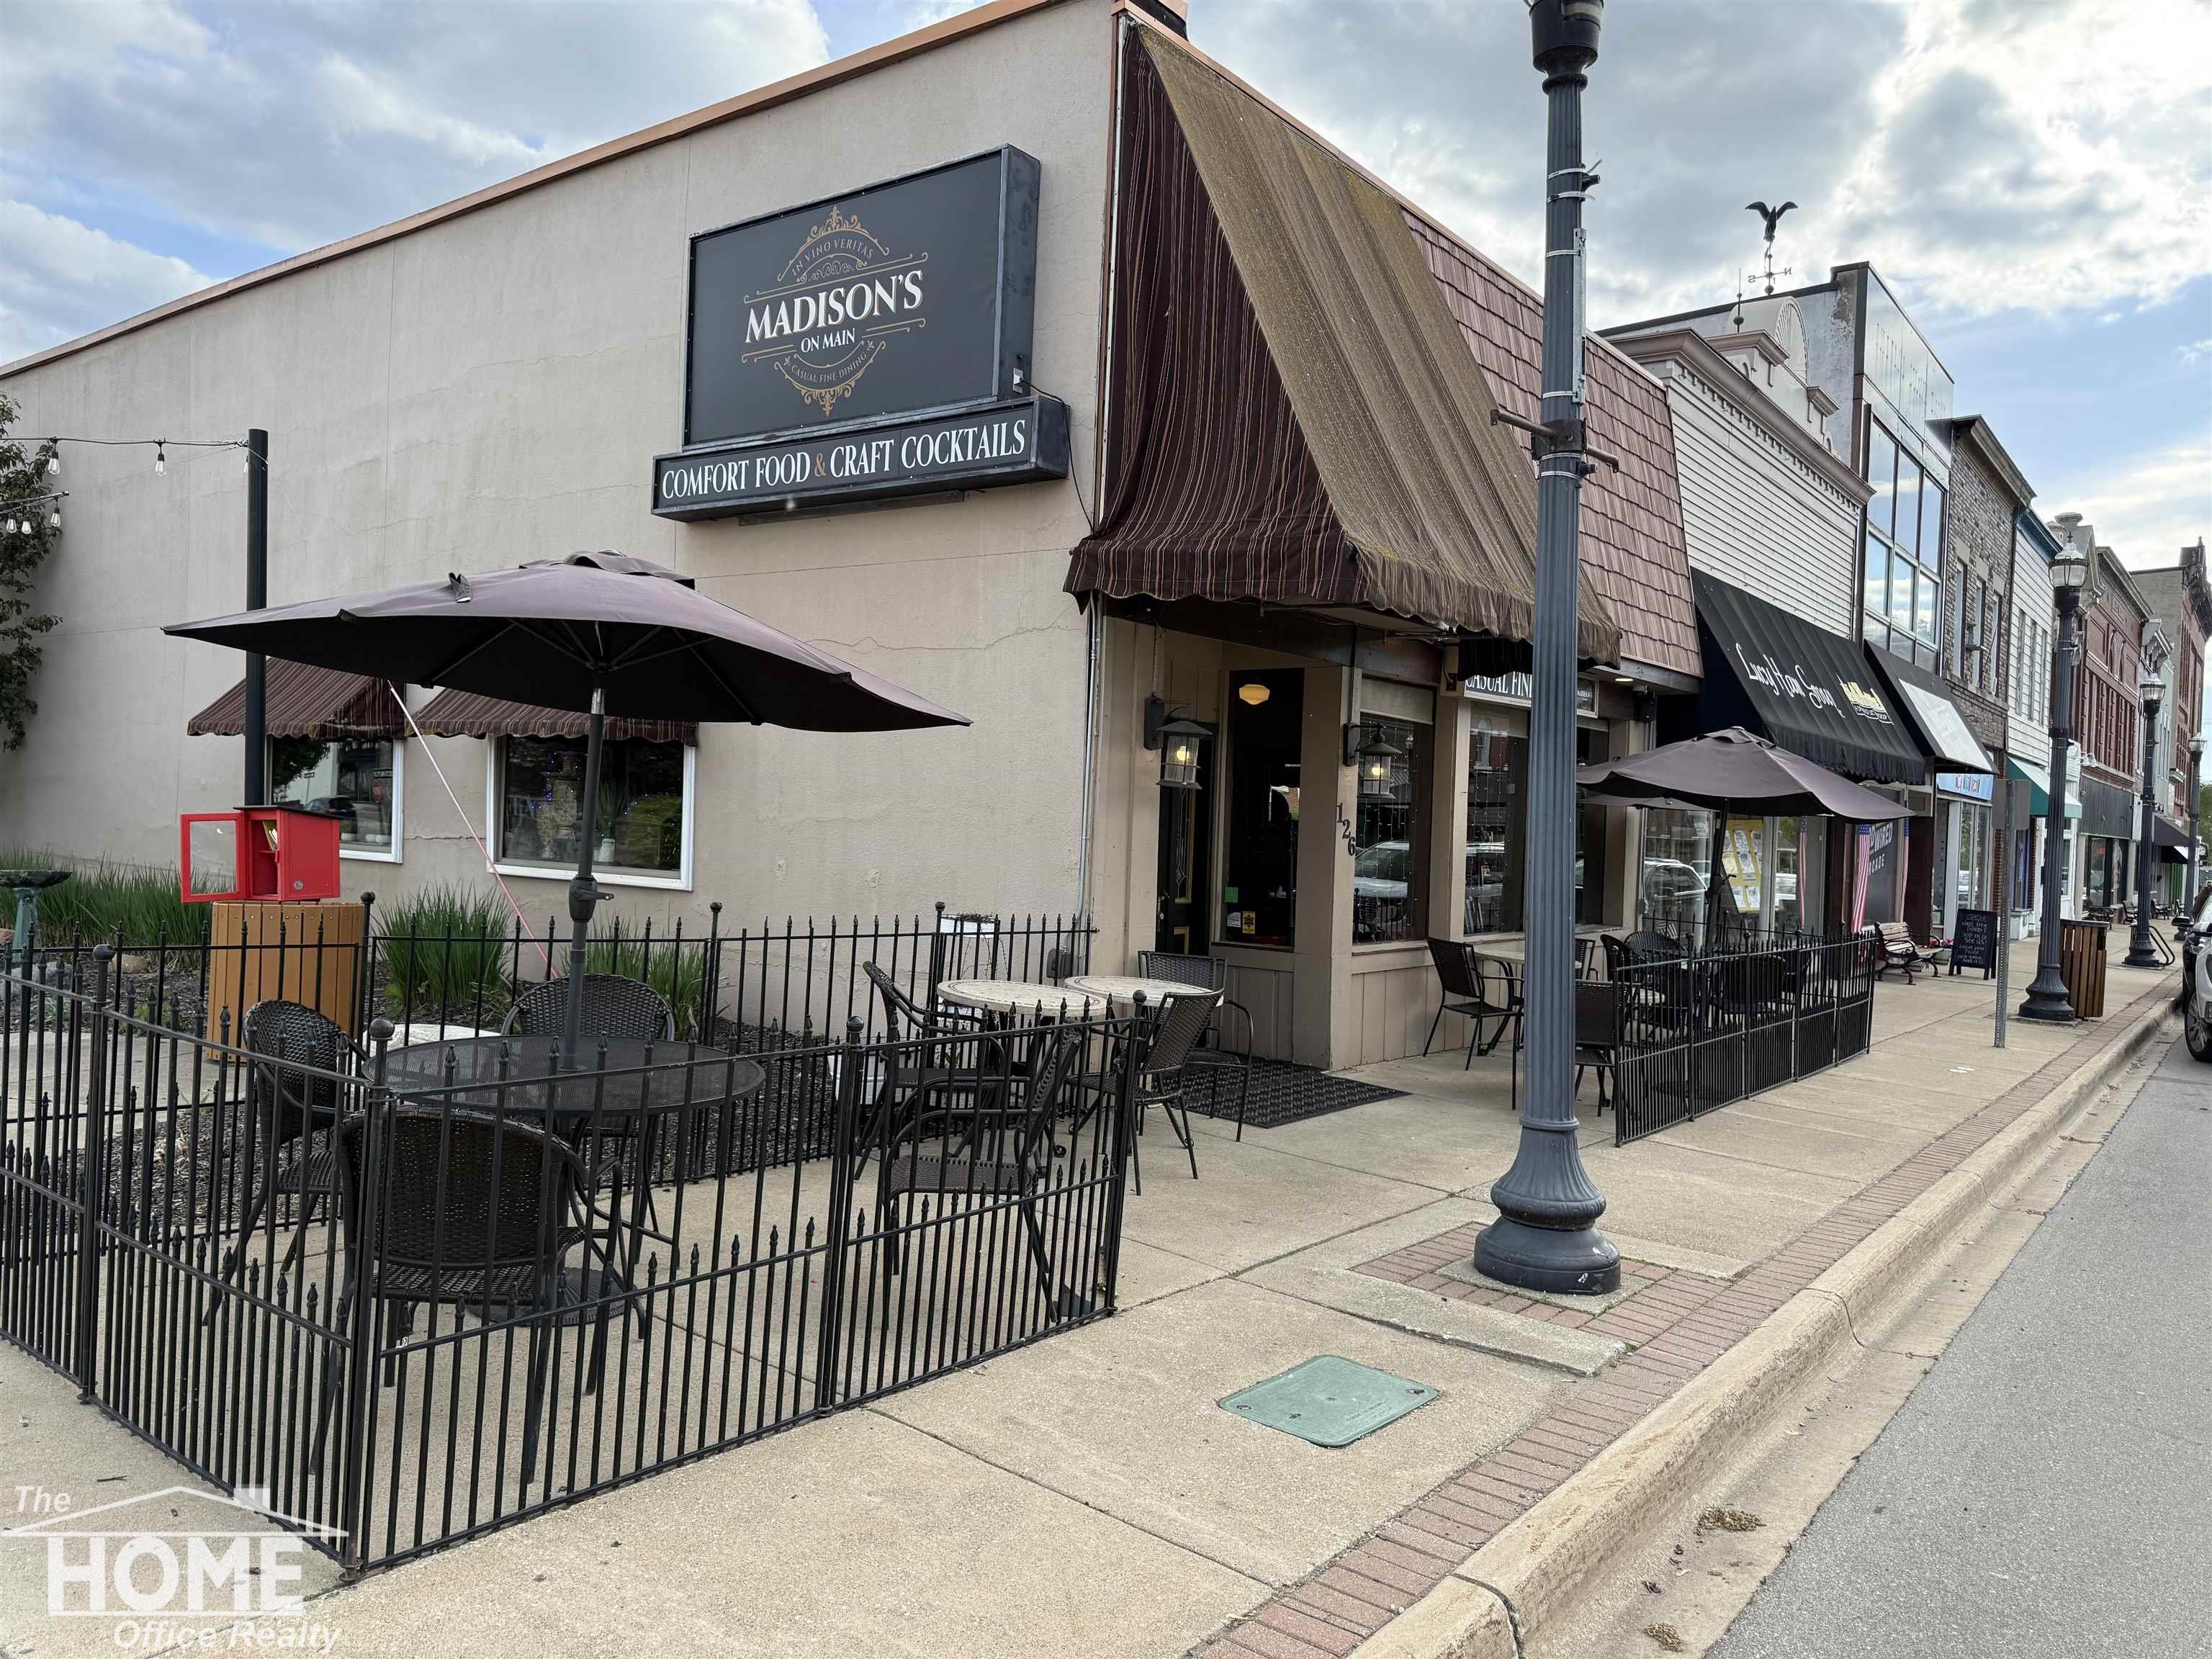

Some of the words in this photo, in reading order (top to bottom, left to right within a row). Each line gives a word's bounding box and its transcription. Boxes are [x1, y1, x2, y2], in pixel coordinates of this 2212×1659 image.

[792, 260, 804, 276] IN
[805, 241, 831, 261] VINO
[834, 238, 873, 259] VERITAS
[745, 269, 924, 343] MADISON'S
[791, 364, 818, 383] CASUAL
[819, 372, 837, 383] FINE
[838, 351, 868, 379] DINING
[801, 335, 819, 353] ON
[822, 328, 855, 349] MAIN
[662, 459, 750, 499] COMFORT
[755, 451, 811, 488] FOOD
[814, 452, 827, 477] &
[830, 439, 894, 478] CRAFT
[901, 420, 1025, 469] COCKTAILS
[1735, 642, 1780, 696] Lucy
[1336, 801, 1356, 857] 126
